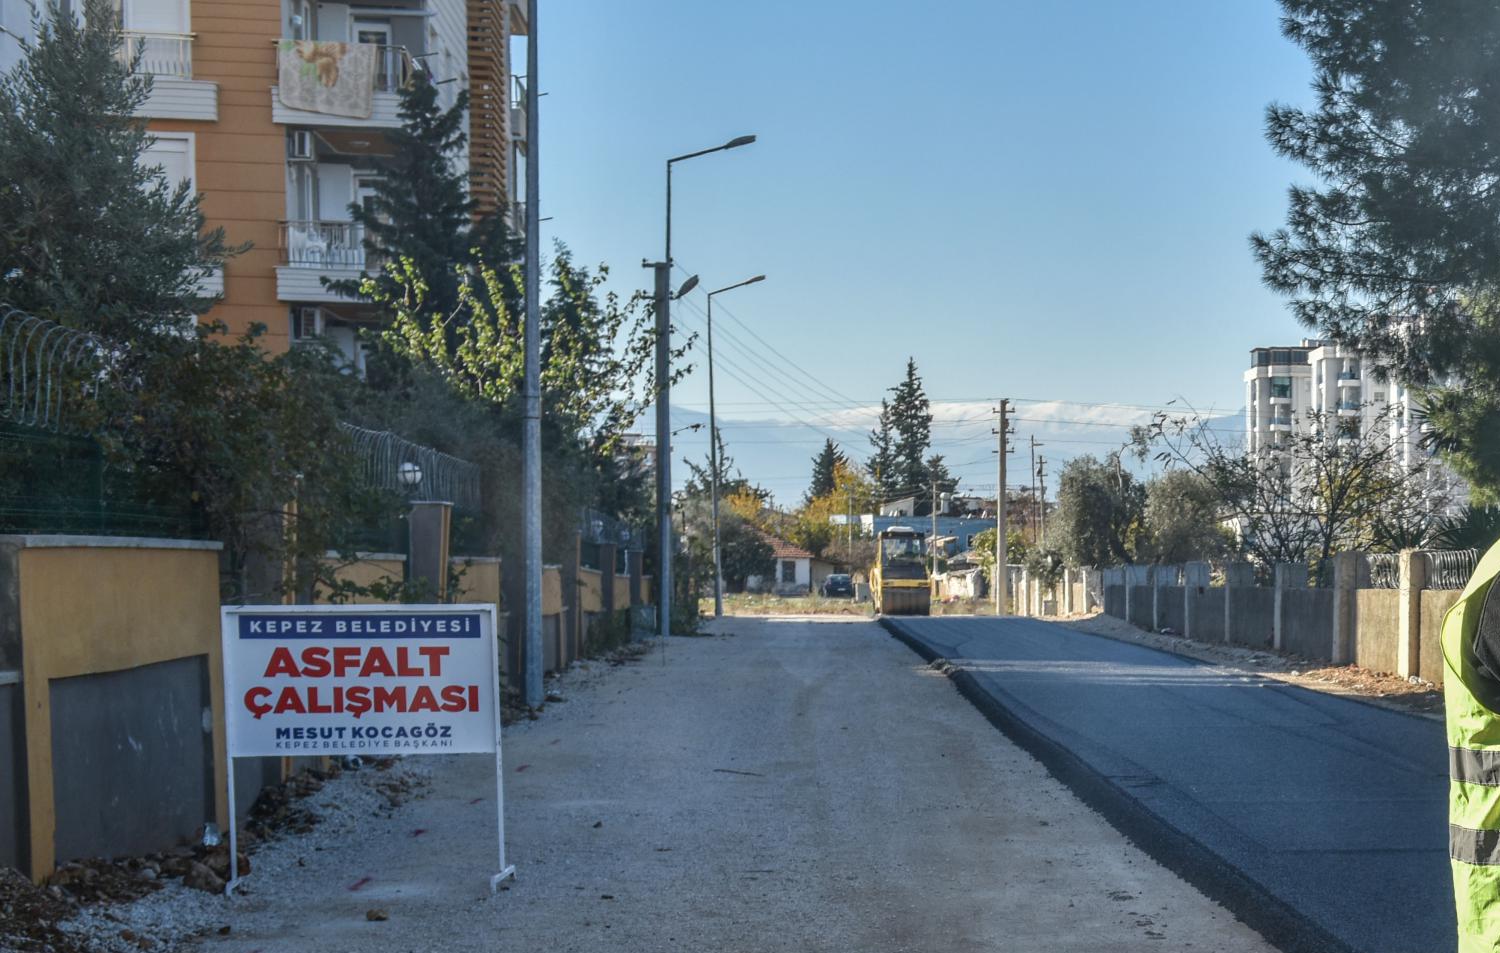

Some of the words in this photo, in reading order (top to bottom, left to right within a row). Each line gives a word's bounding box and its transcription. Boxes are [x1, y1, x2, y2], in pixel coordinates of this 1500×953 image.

[250, 620, 323, 634] KEPEZ
[336, 617, 471, 633] BELEDİYESİ
[263, 646, 450, 678] ASFALT
[243, 685, 480, 720] ÇALIŞMASI
[275, 727, 346, 740] MESUT
[352, 722, 452, 739] KOCAGÖZ
[275, 741, 318, 749] KEPEZ
[394, 739, 453, 749] BAŞKANI
